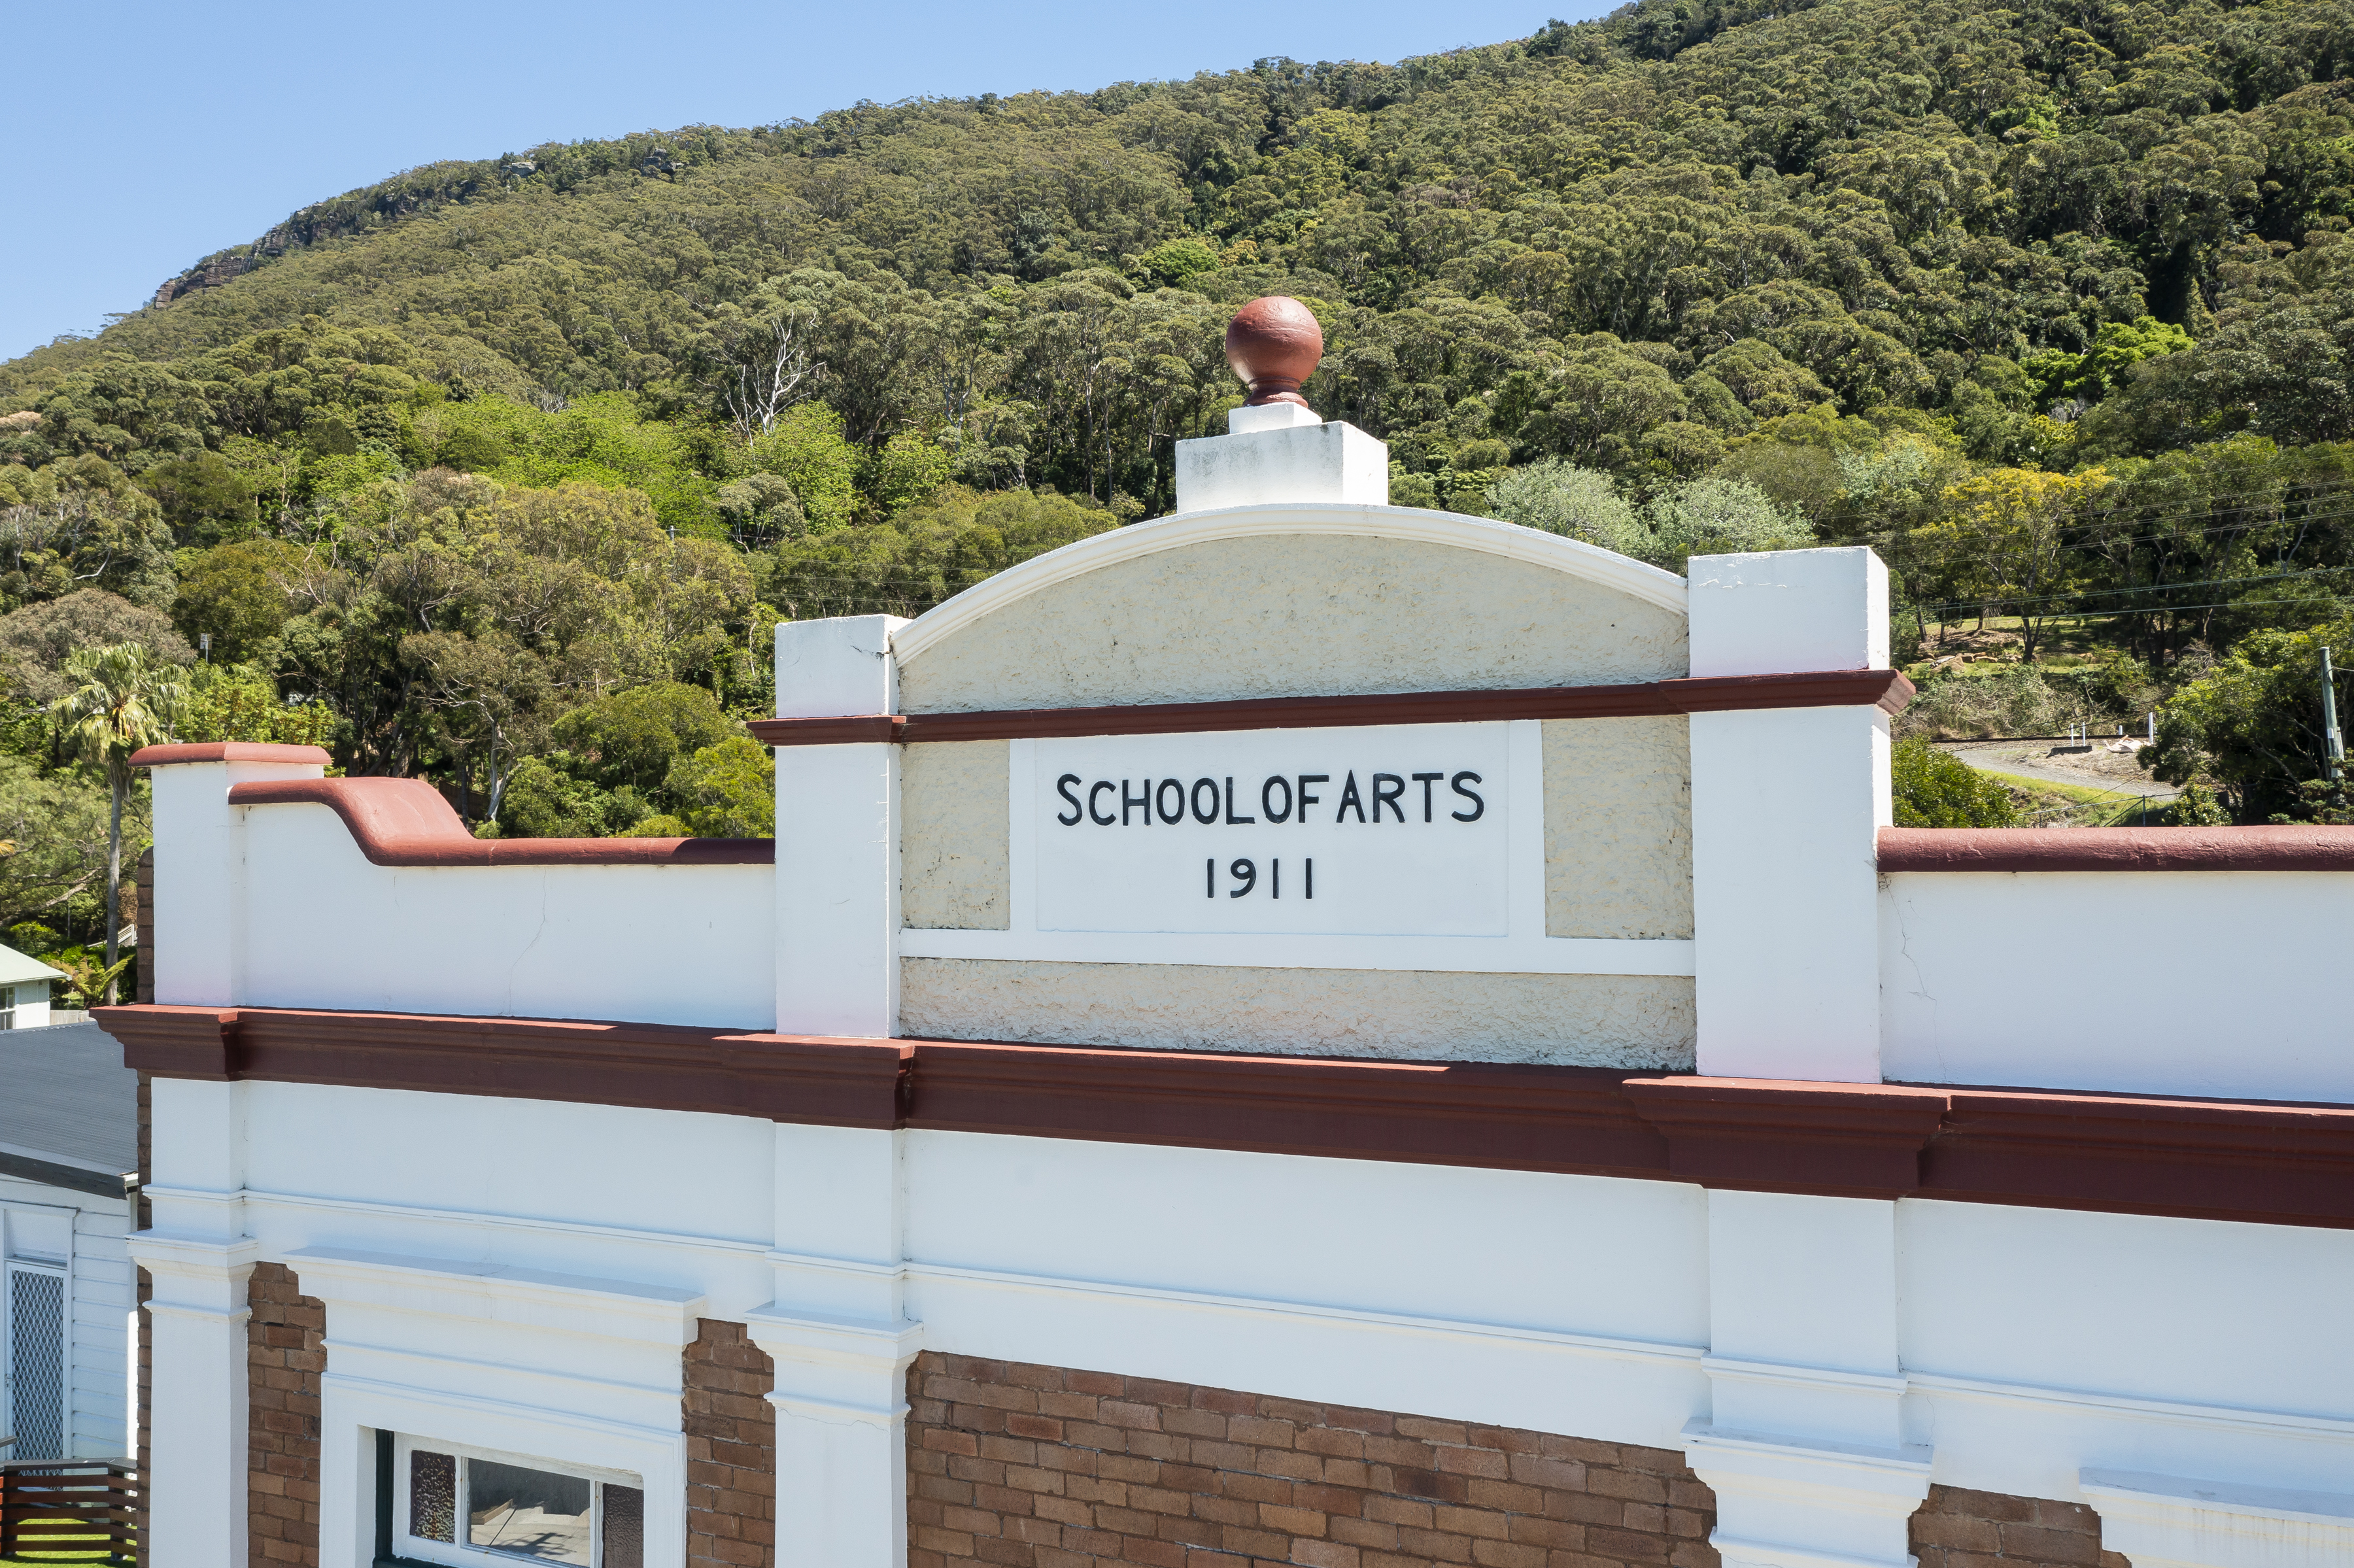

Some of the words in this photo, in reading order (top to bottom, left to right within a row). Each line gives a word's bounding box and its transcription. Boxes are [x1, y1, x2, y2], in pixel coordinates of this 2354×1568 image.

[1057, 774, 1256, 827] SCHOOL
[1261, 774, 1329, 825] OF
[1336, 769, 1485, 824] ARTS
[1206, 857, 1312, 900] 1911
